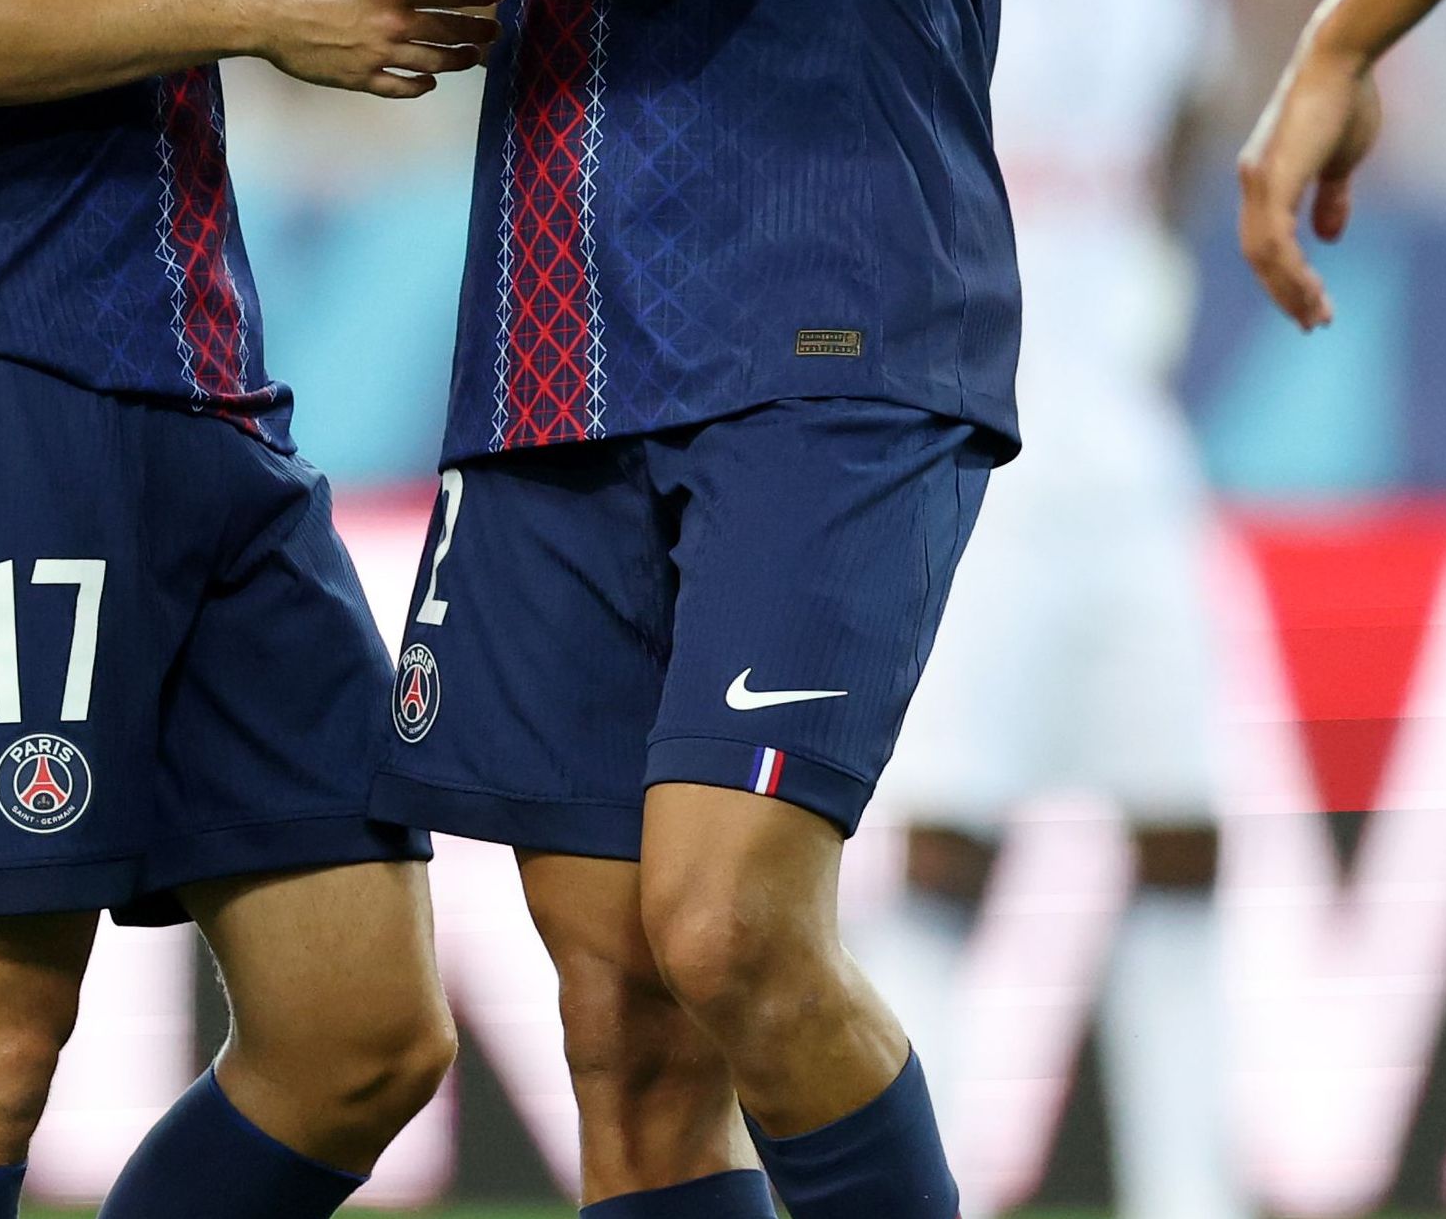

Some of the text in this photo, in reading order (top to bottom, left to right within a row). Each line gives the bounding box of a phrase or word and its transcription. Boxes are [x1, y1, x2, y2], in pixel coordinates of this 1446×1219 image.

[416, 468, 464, 627] 2
[403, 648, 434, 675] PARIS
[9, 738, 74, 764] PARIS
